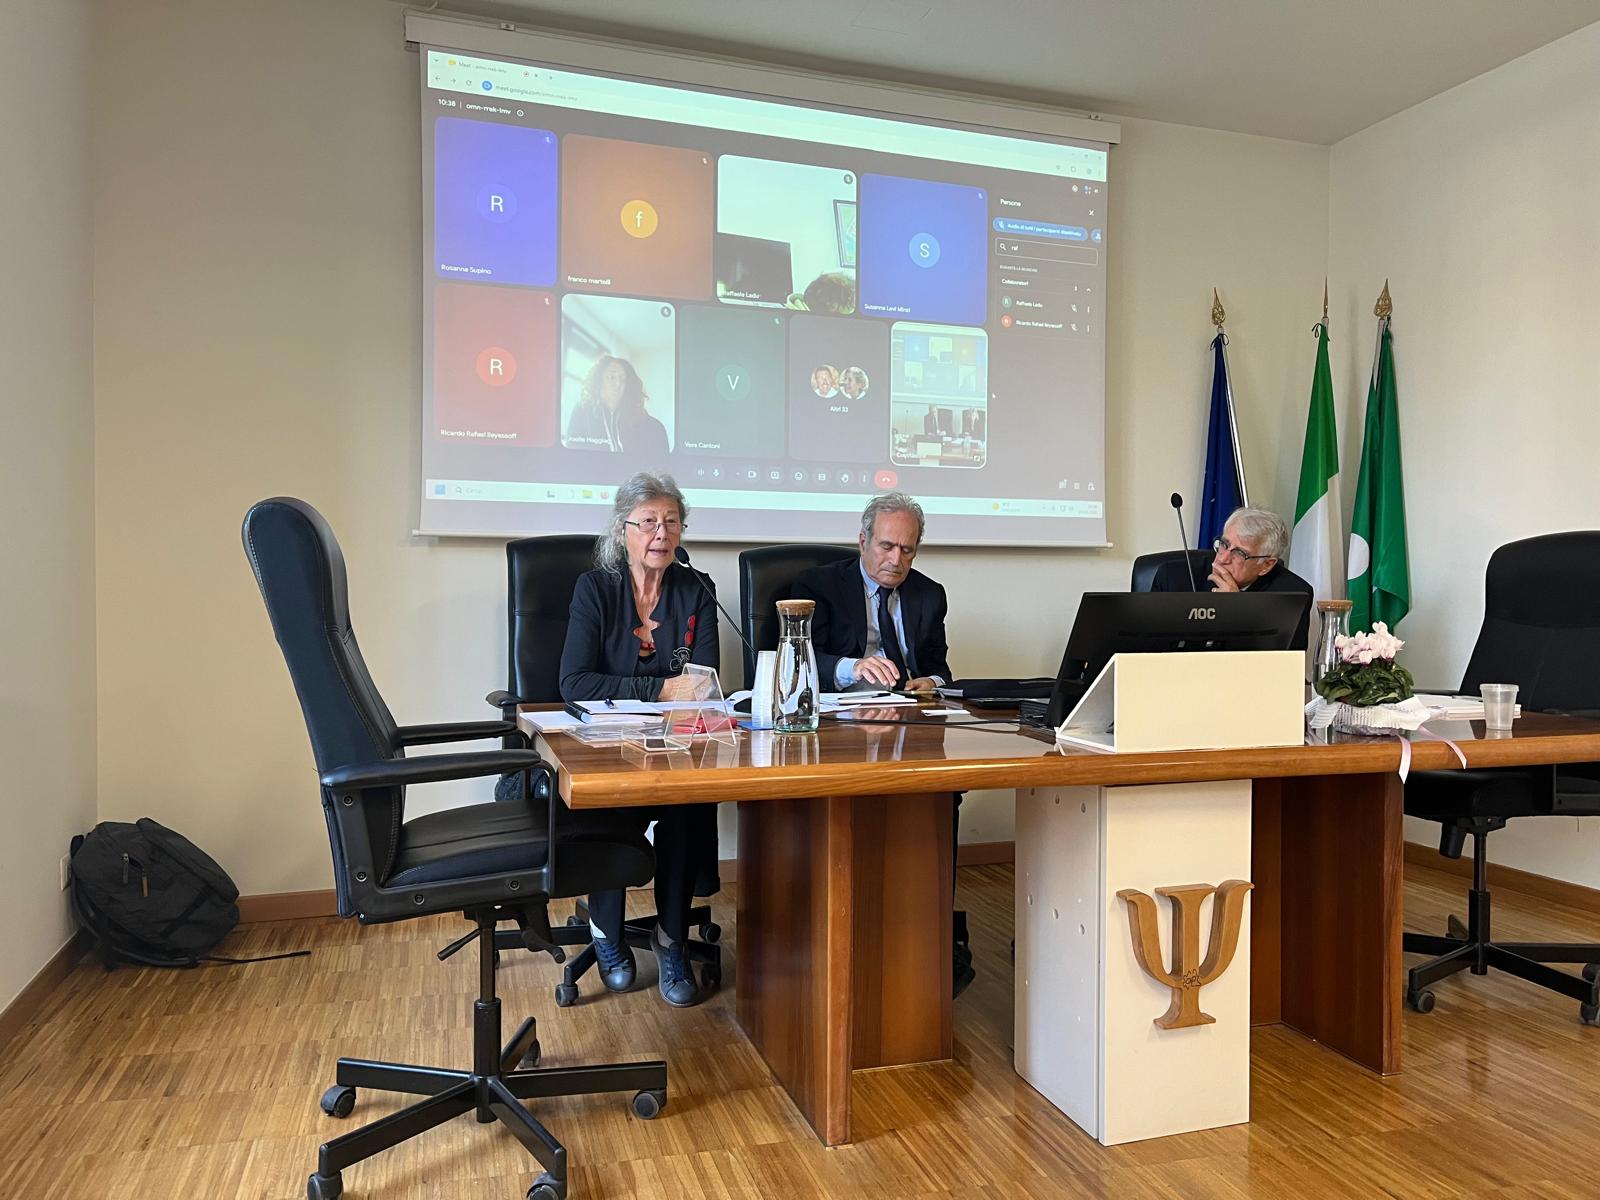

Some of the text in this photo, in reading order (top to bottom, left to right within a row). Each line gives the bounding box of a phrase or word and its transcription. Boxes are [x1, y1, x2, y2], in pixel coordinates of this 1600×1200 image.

[438, 98, 456, 107] 10:38
[491, 195, 504, 213] R
[1000, 199, 1021, 207] Persone
[635, 211, 643, 228] f
[919, 243, 931, 258] S
[567, 275, 588, 283] franco
[490, 359, 503, 376] R
[727, 375, 740, 391] V
[440, 429, 466, 437] Ricardo
[1188, 607, 1216, 620] AOC
